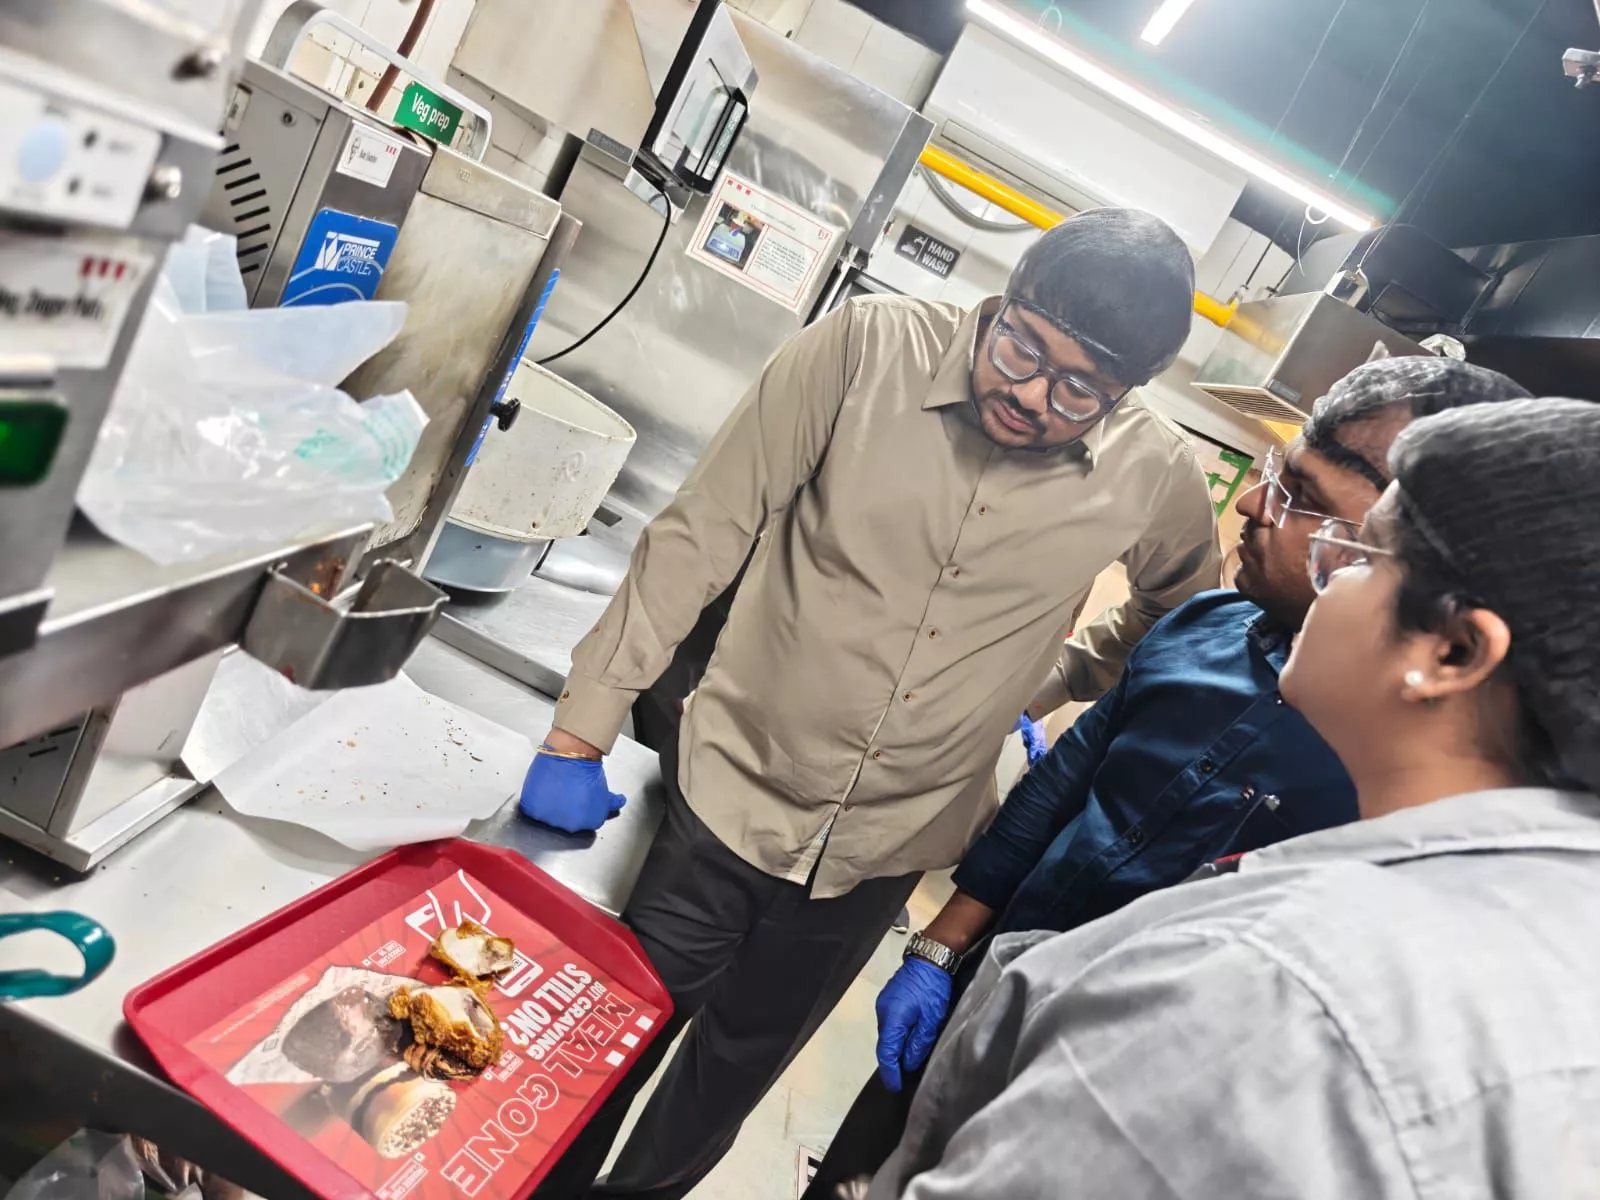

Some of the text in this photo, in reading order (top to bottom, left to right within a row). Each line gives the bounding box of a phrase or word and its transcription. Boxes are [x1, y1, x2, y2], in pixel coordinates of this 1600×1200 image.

[412, 92, 450, 132] Veg prep
[336, 258, 370, 275] CASTLE
[342, 242, 378, 260] PRINCE
[921, 253, 949, 275] WASH
[928, 241, 955, 262] HAND
[500, 963, 592, 1046] STILL ON?
[526, 981, 607, 1060] BUT CRAVING
[440, 992, 636, 1197] MEAL GONE
